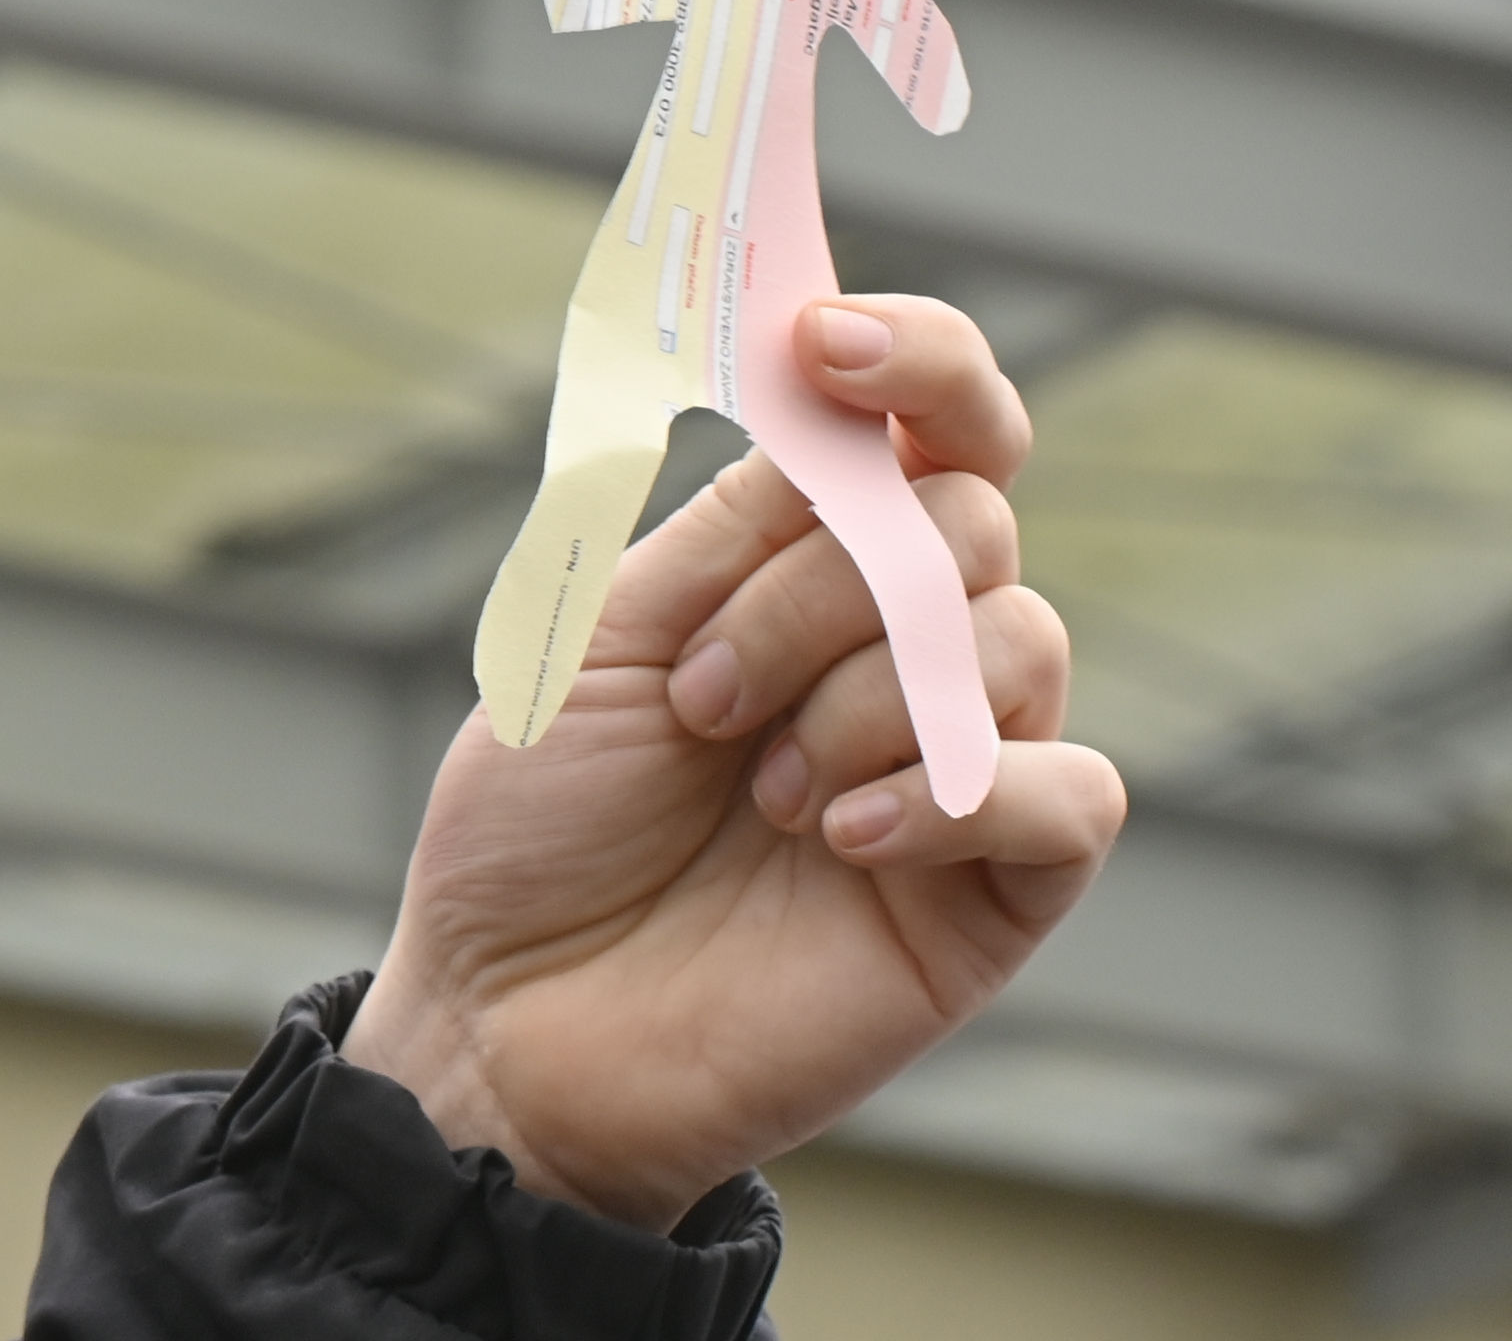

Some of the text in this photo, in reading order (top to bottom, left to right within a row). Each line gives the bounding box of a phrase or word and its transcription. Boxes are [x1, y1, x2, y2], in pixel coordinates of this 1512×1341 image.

[653, 97, 671, 137] 073
[719, 240, 738, 358] ZDRAVSTVENO
[565, 538, 581, 572] UPN
[543, 584, 568, 657] Univerzalni
